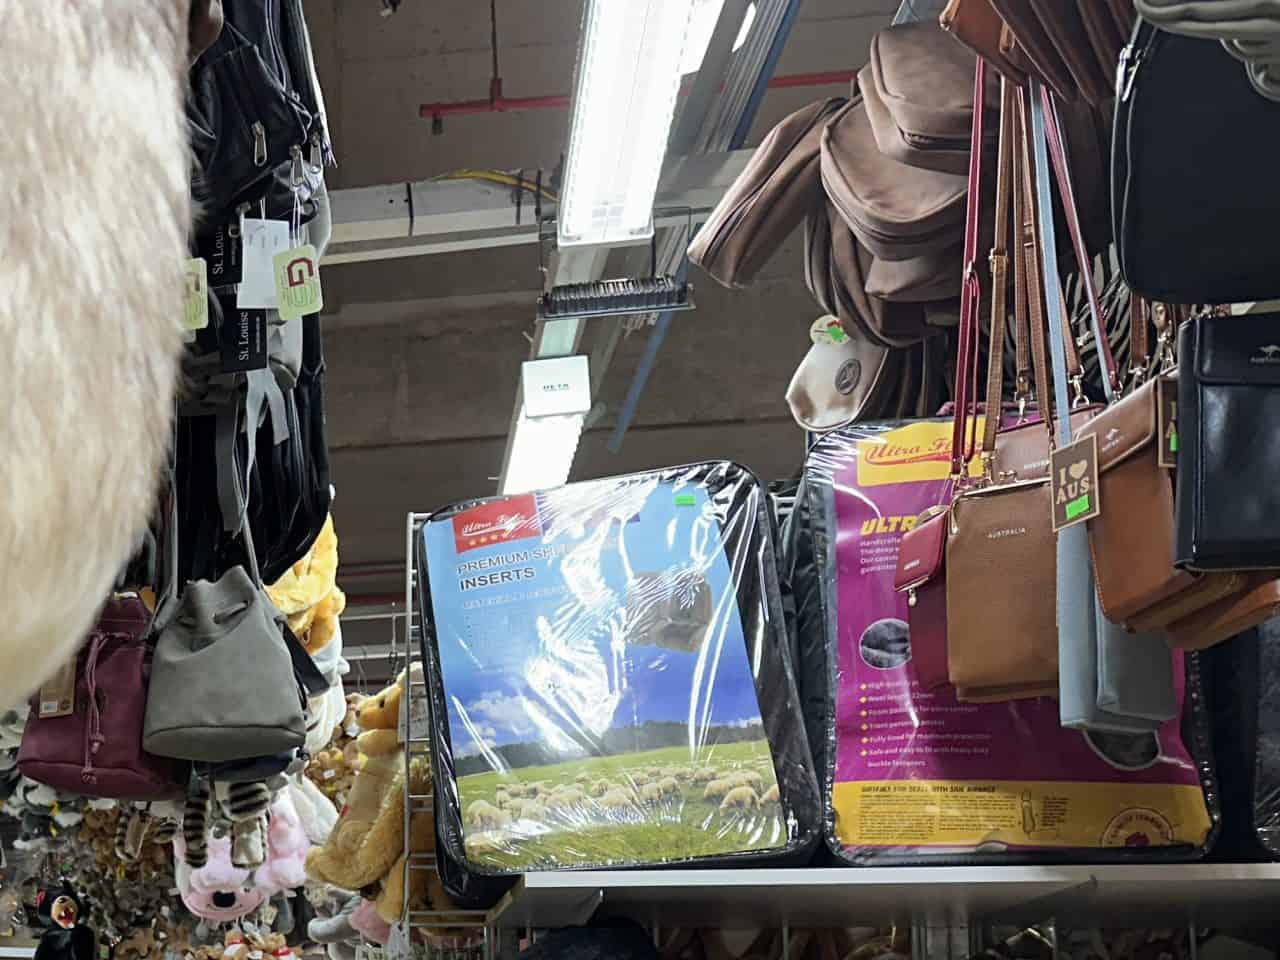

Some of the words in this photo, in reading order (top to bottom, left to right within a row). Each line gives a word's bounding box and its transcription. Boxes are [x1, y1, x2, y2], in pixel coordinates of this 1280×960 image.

[238, 311, 250, 343] Louise
[1055, 476, 1090, 505] AUS
[860, 514, 921, 536] ULTR
[456, 550, 529, 575] PREMIUM
[459, 567, 536, 592] INSERTS
